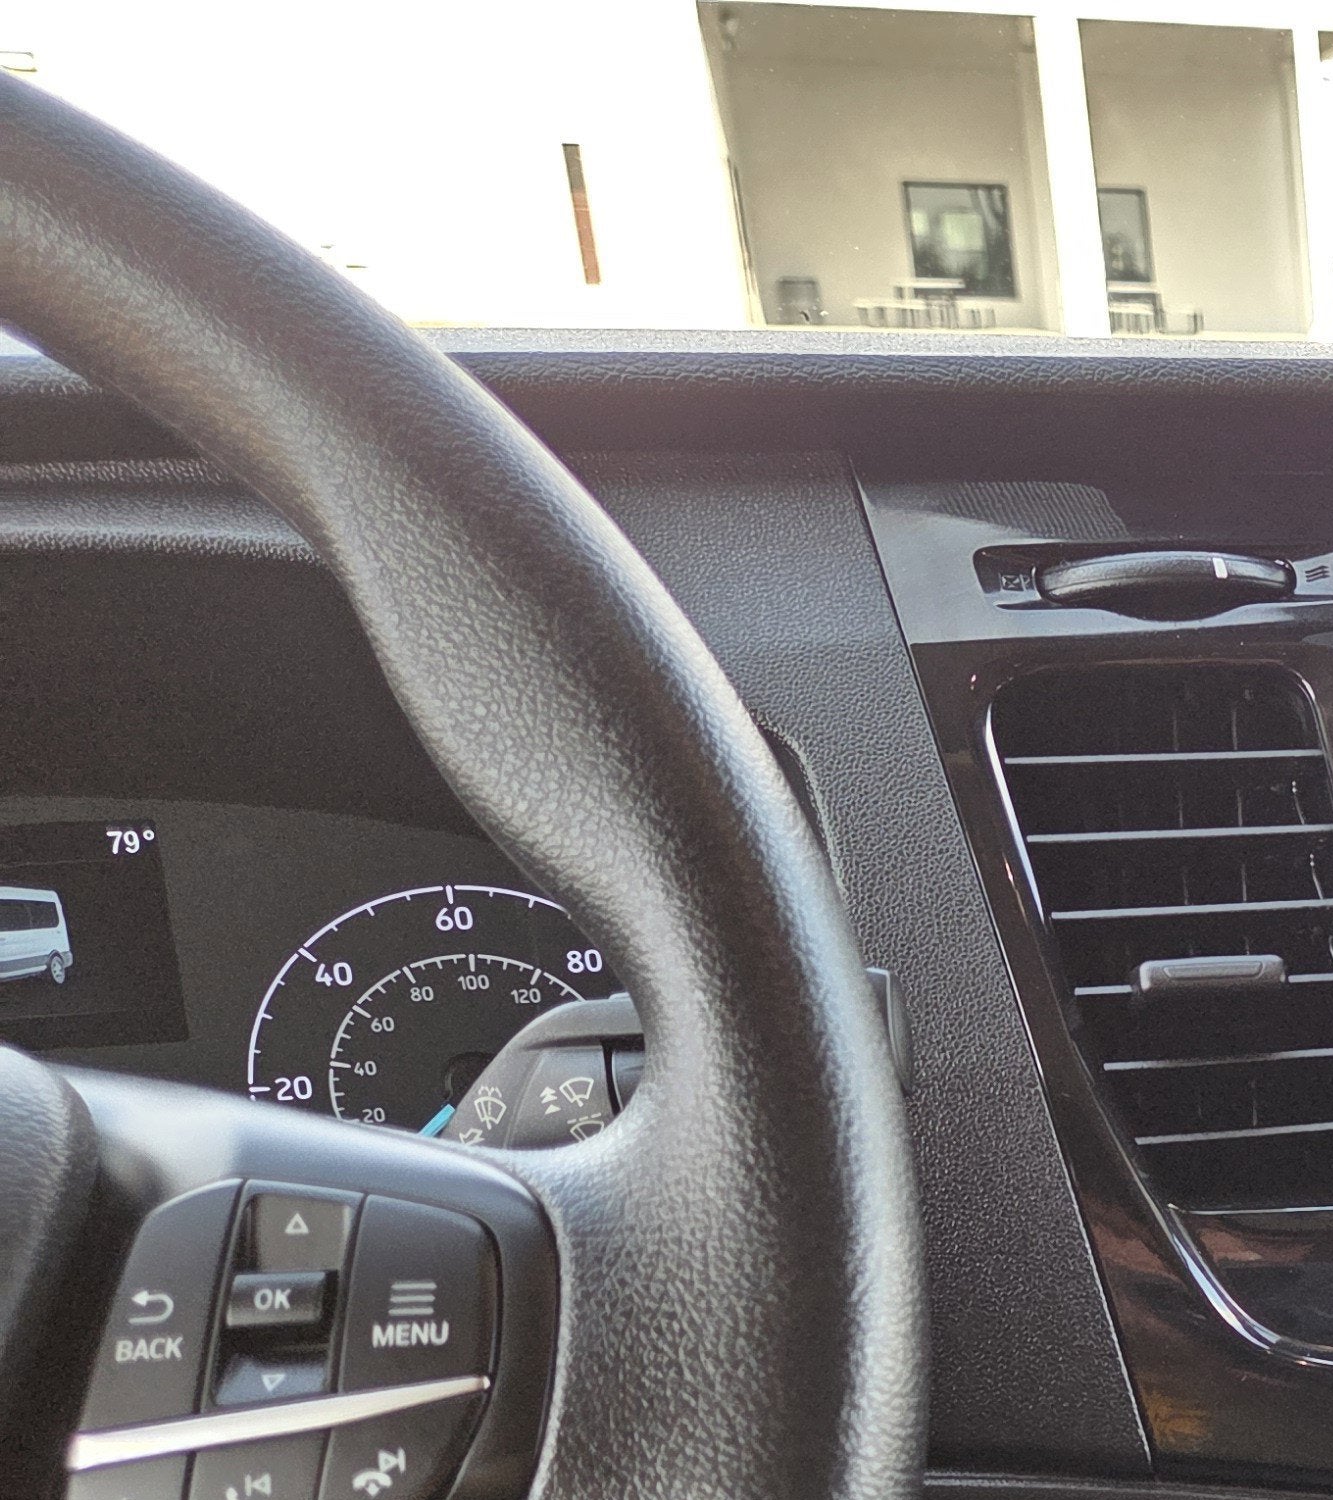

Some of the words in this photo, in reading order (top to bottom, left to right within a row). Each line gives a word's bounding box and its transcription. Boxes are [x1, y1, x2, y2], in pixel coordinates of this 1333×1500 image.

[435, 905, 473, 931] 60
[566, 949, 602, 974] 80
[315, 961, 352, 987] 40
[457, 973, 491, 992] 100
[410, 985, 434, 1003] 80
[510, 987, 542, 1005] 120
[371, 1016, 394, 1033] 60
[353, 1060, 377, 1077] 40
[274, 1075, 313, 1101] 20
[362, 1107, 386, 1123] 20
[253, 1287, 291, 1311] OK
[371, 1321, 449, 1348] MENU
[115, 1335, 184, 1363] BACK
